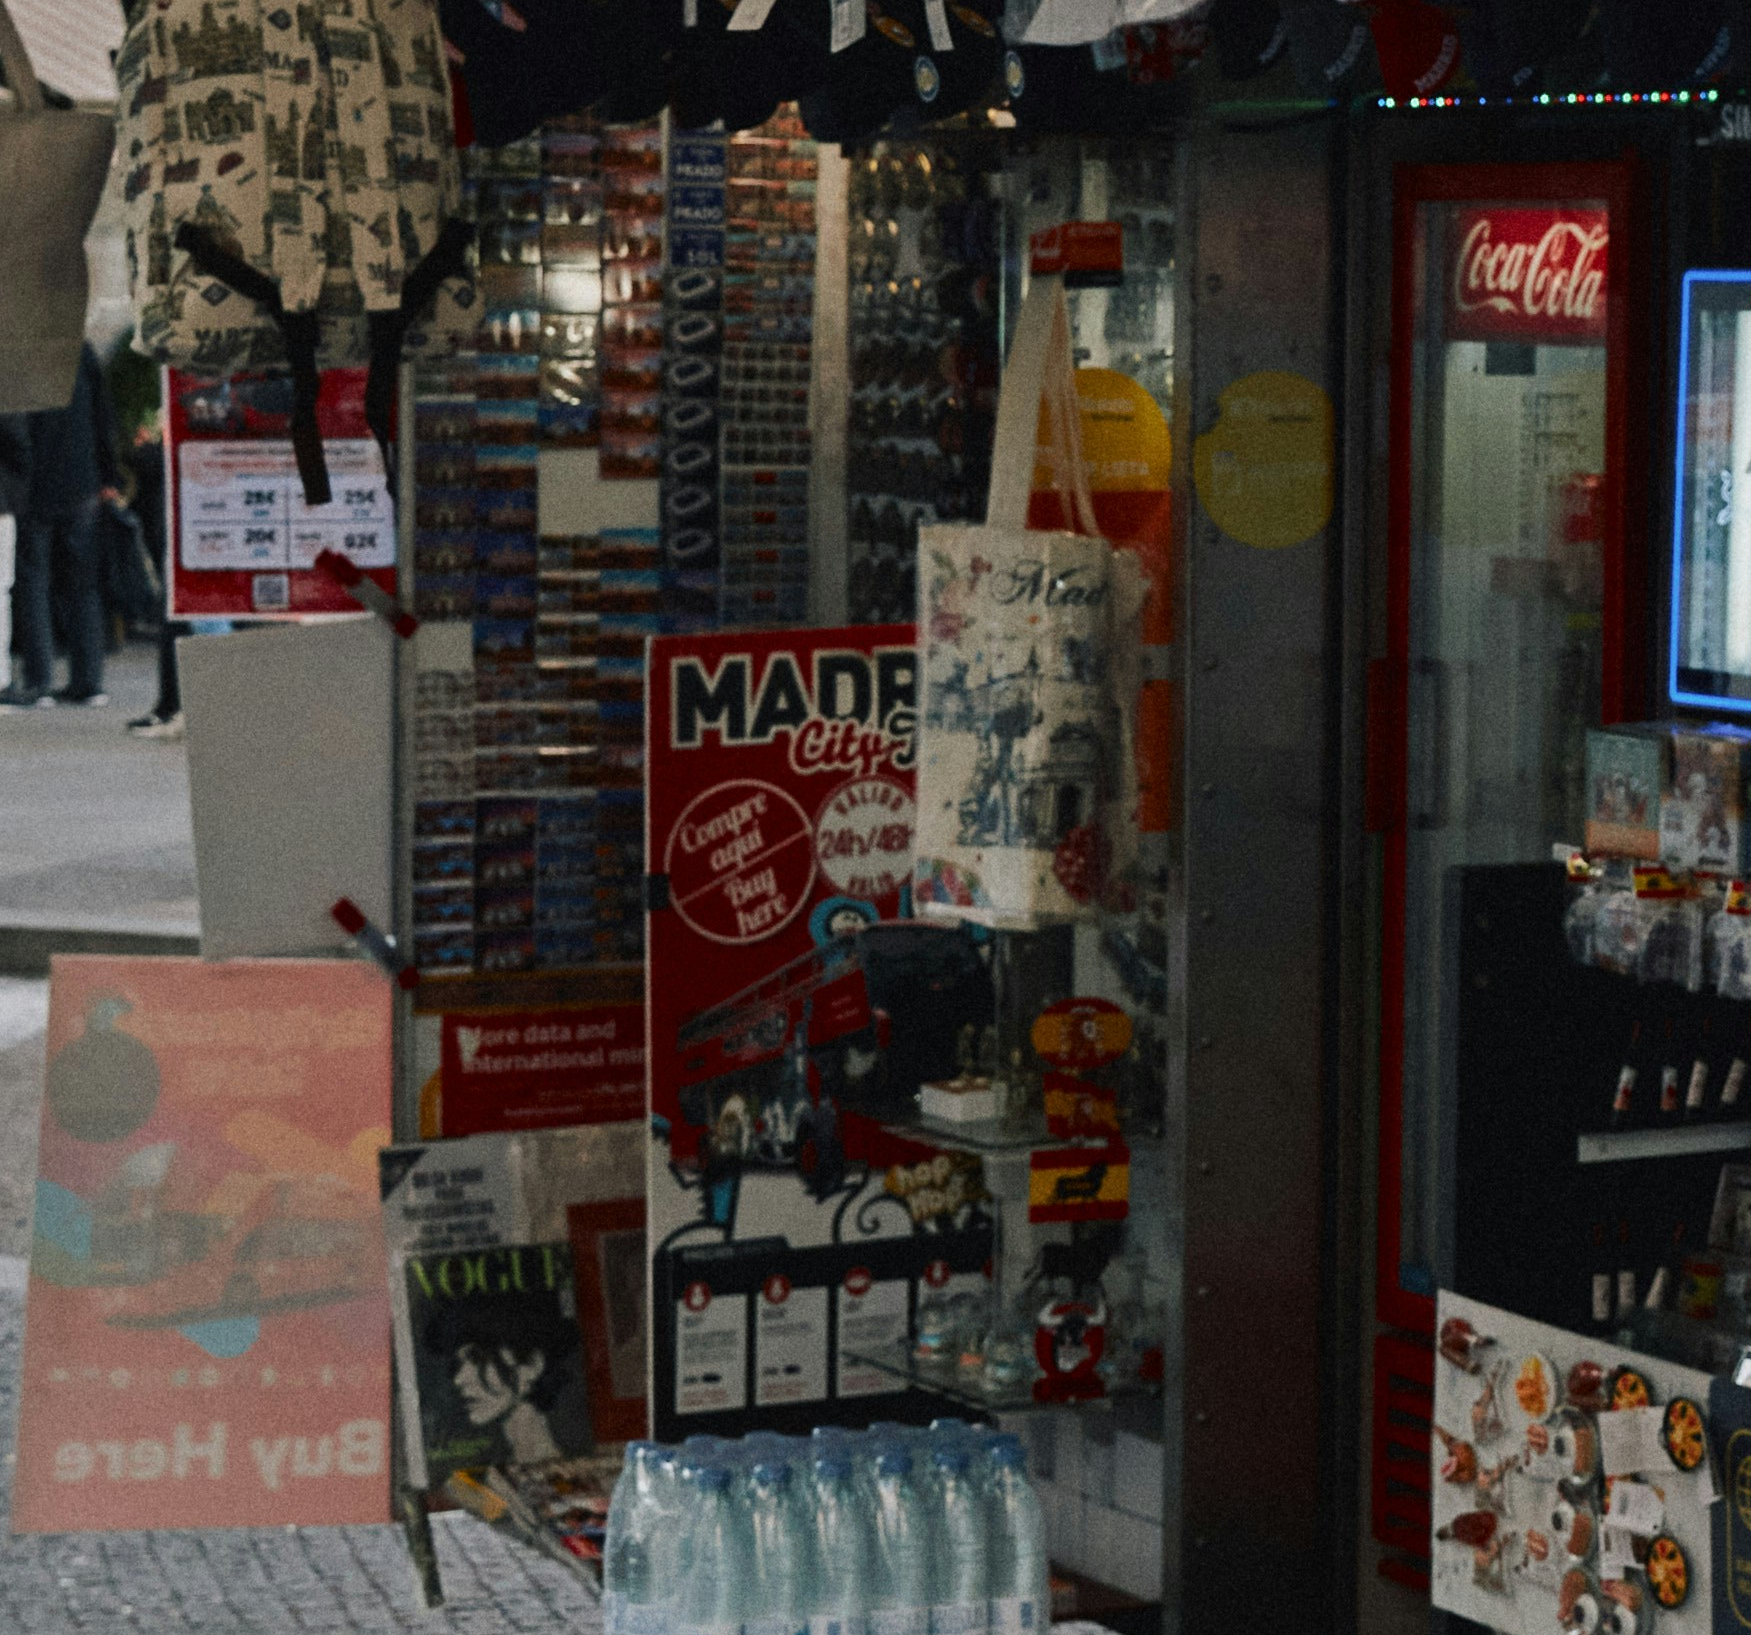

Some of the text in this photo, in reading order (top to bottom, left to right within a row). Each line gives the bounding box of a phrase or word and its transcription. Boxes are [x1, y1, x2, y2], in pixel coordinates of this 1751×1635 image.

[679, 792, 770, 855] Compre
[723, 865, 778, 909] Buy
[736, 893, 789, 936] here
[523, 1020, 617, 1046] data and
